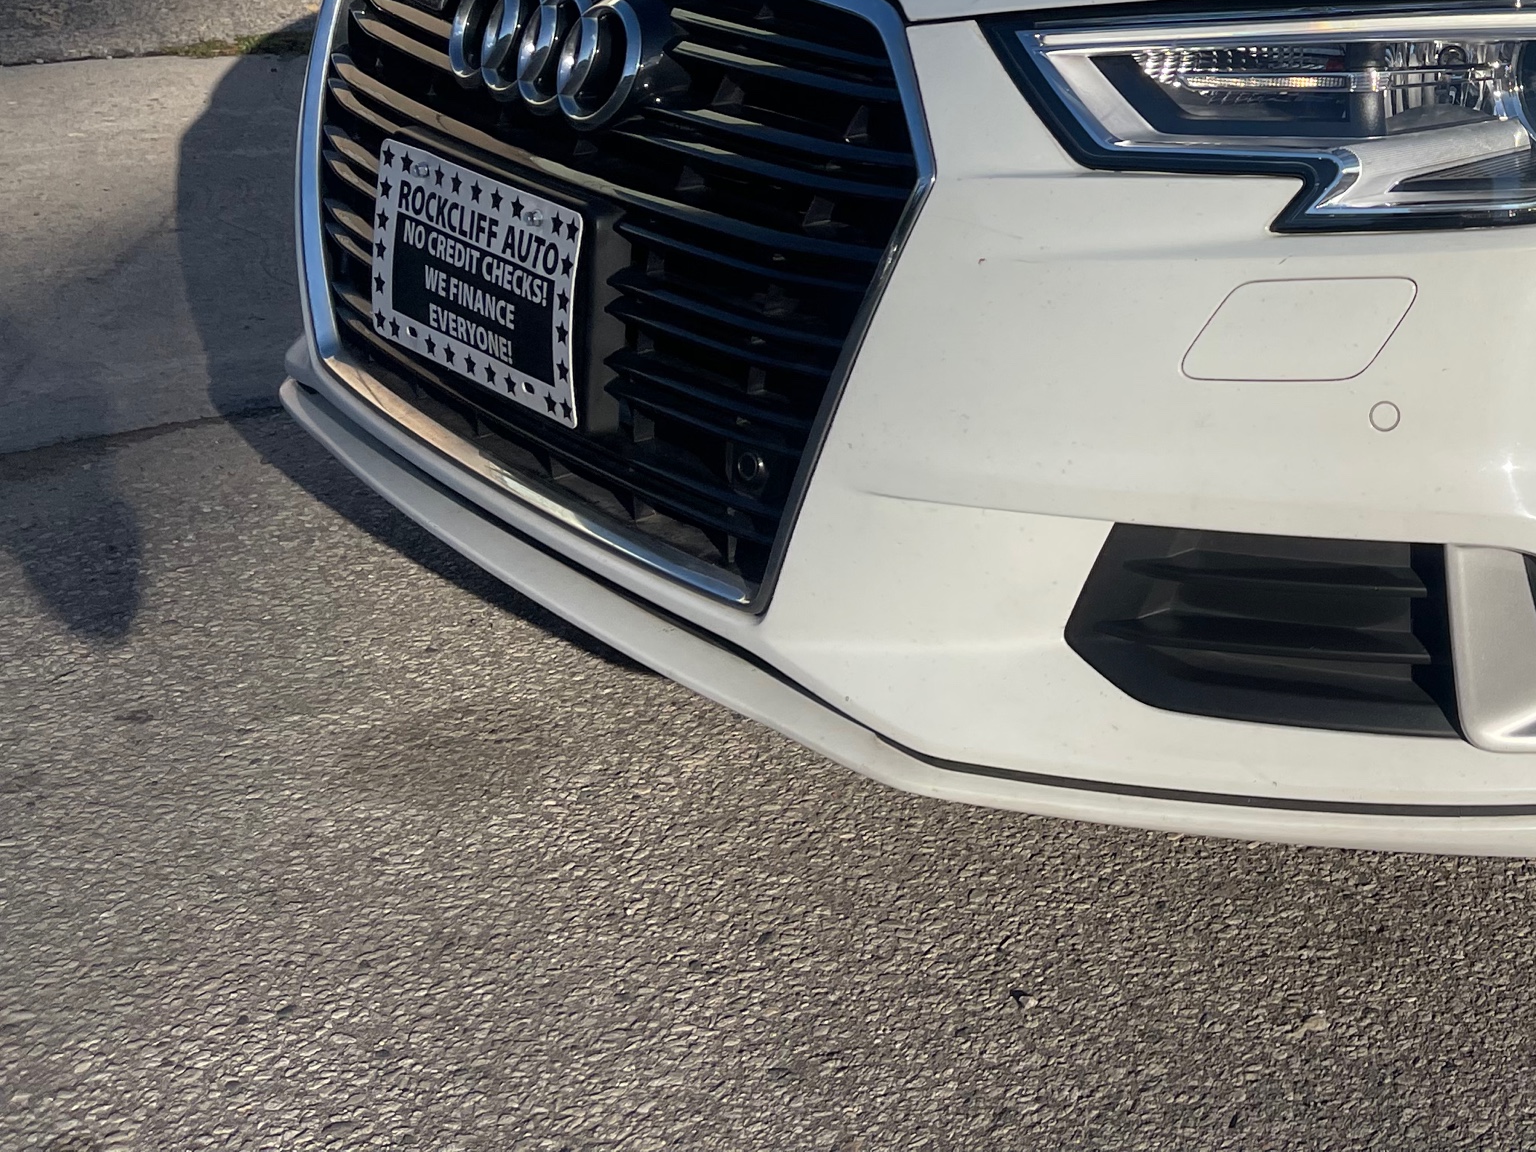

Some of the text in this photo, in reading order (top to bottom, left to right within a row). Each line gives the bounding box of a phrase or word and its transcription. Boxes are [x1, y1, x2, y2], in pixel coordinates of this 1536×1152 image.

[398, 179, 559, 275] ROCKCLIFF AUTO
[403, 219, 548, 307] NO CREDIT CHECKS!
[424, 264, 515, 330] WE FINANCE
[429, 302, 513, 365] EVERYONE!
